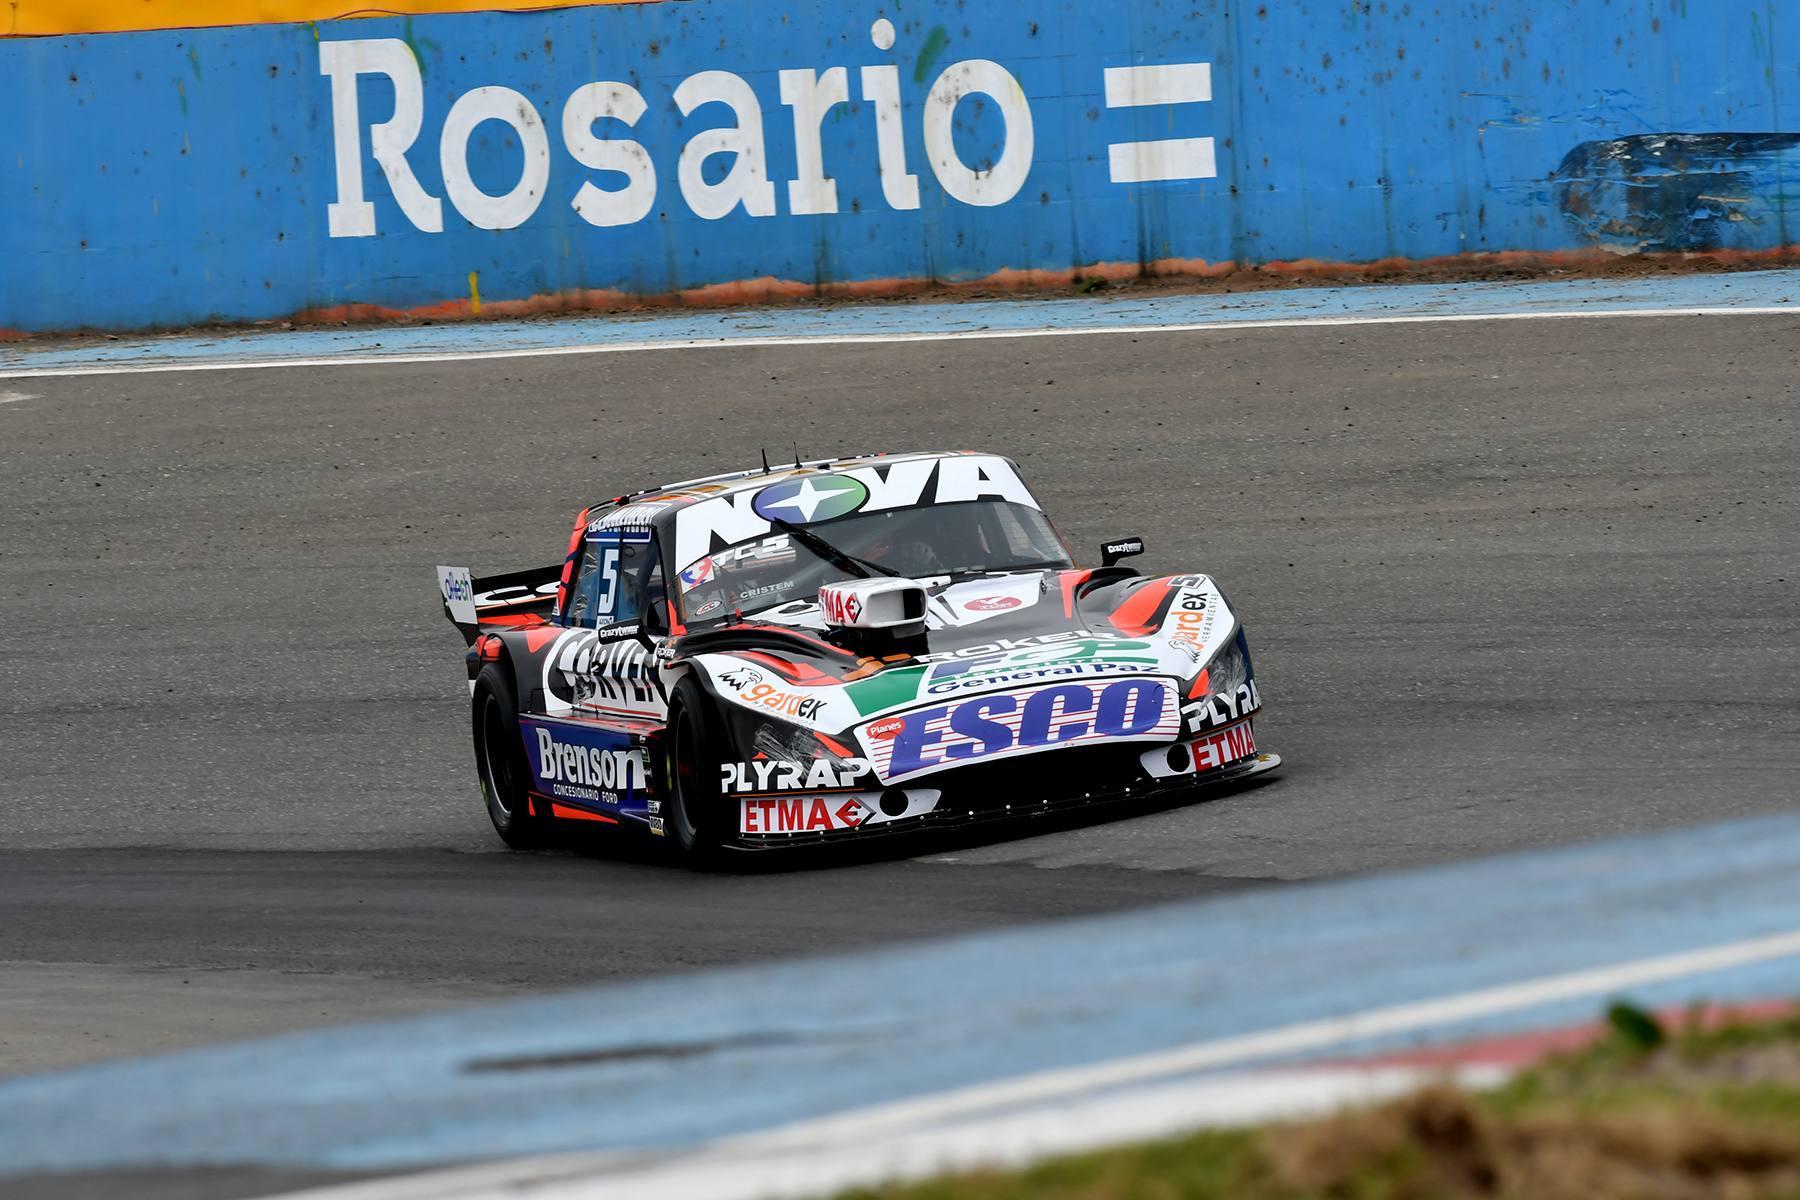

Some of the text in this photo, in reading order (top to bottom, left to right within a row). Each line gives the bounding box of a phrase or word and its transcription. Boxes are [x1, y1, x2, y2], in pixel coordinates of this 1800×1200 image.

[319, 17, 1034, 237] Rosario
[598, 548, 619, 613] 5
[740, 581, 794, 599] CRISTEM
[914, 630, 1125, 663] ROKER
[928, 660, 1160, 695] General Paz
[869, 719, 903, 736] Planes
[888, 679, 1165, 777] ESCO
[536, 727, 647, 790] Brenson
[1191, 723, 1257, 772] ETMA
[721, 757, 871, 793] PLYRAP
[553, 783, 618, 804] CONCESIONARIO FORD
[745, 798, 834, 832] ETMA
